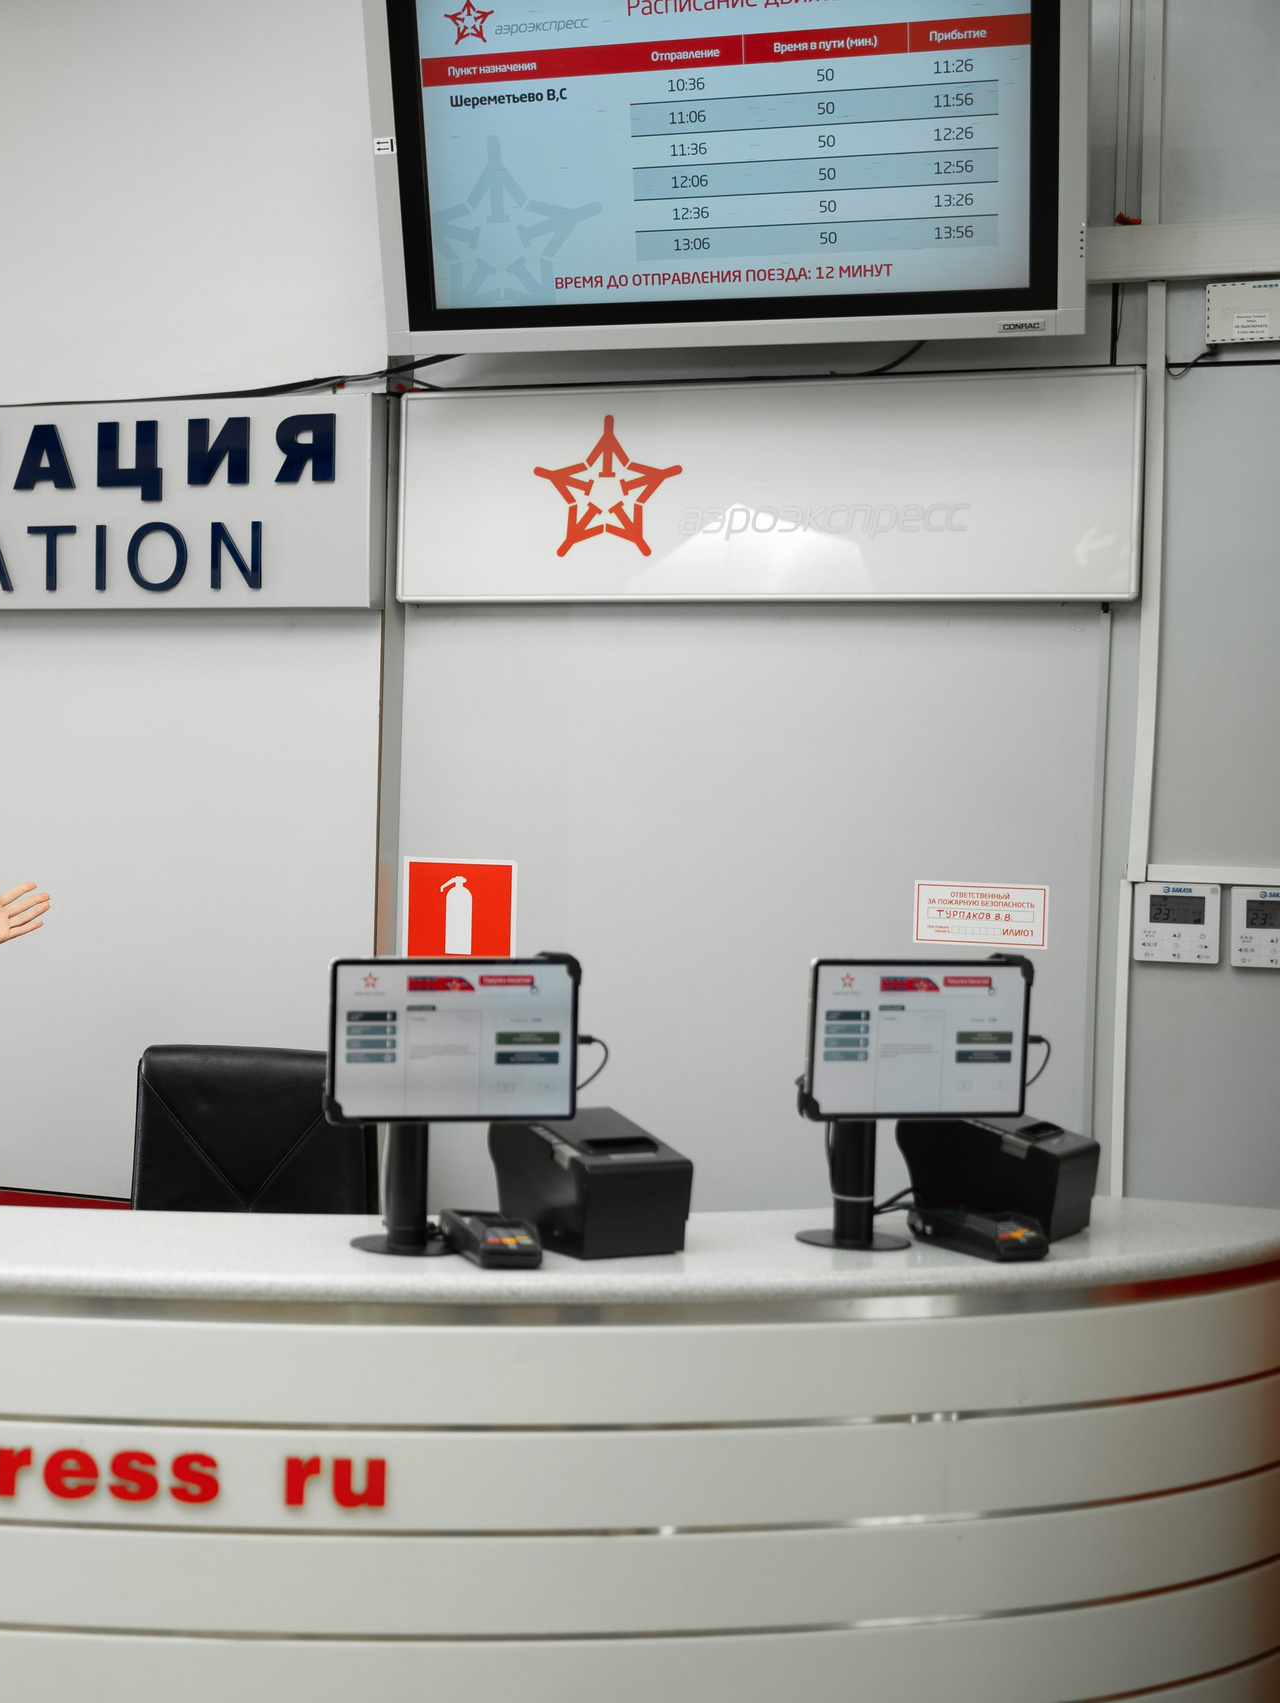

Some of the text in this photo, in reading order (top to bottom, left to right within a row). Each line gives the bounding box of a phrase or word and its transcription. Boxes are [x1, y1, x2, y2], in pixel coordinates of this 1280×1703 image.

[494, 17, 589, 36] аэроэкспресс
[929, 27, 987, 42] Прибытие
[651, 48, 720, 63] Отправление
[773, 34, 878, 54] Время в пути (мин.)
[447, 61, 537, 77] Пункт назначения
[667, 58, 974, 93] 10:36 50 11:26
[449, 88, 568, 109] Шереметьево В,С
[668, 92, 974, 125] 11:06 50 11:56
[669, 126, 974, 157] 11:36 50 12:26
[671, 159, 974, 189] 12:06 50 12:56
[672, 192, 974, 221] 12:36 50 13:26
[673, 225, 974, 252] 13:06 50 13:56
[554, 262, 893, 290] ВРЕМЯ ДО ОТПРАВЛЕНИЯ ПОЕЗДА: 12 МИНУТ
[1002, 322, 1040, 331] CONRAC
[677, 502, 972, 541] аэроэкспресс
[937, 898, 980, 907] ПОЖАРНУЮ
[980, 900, 1035, 909] БЕЗОПАСНОСТЬ
[950, 891, 1011, 900] ОТВЕТСТВЕННЫЙ
[284, 1454, 387, 1508] ru
